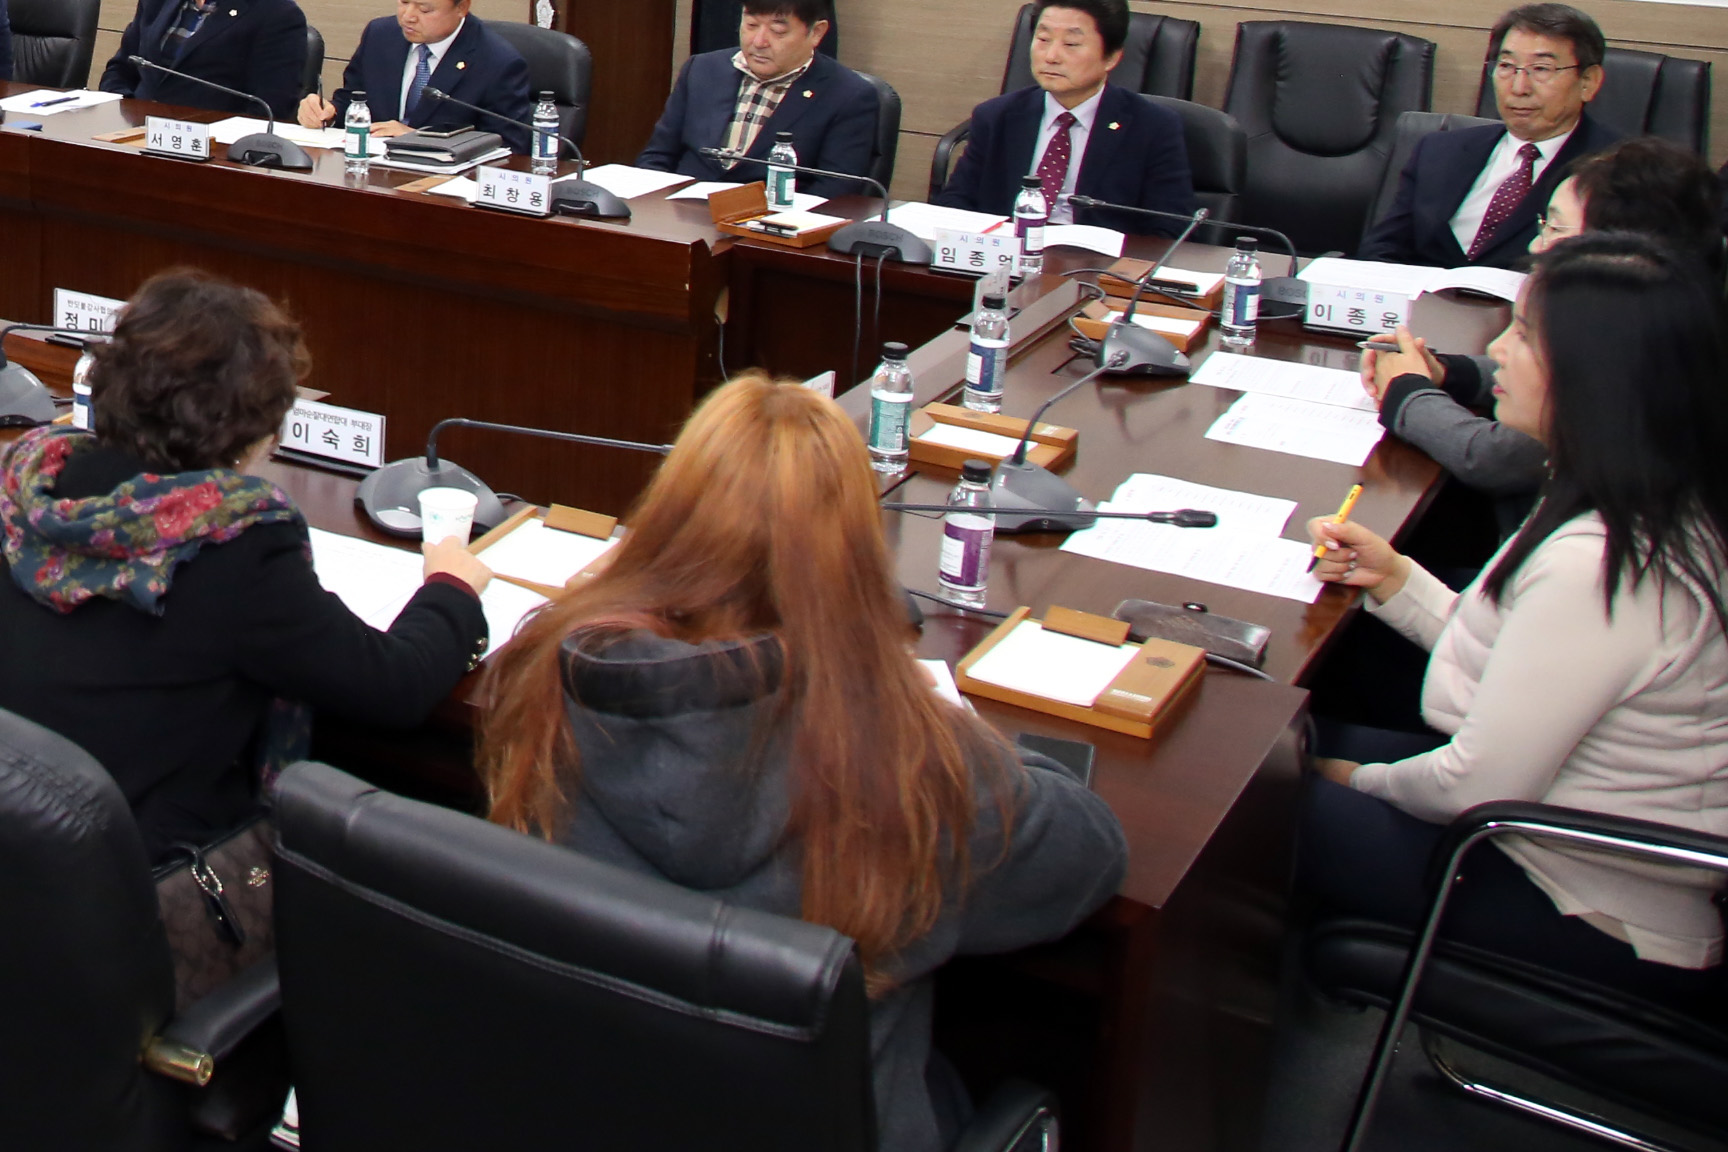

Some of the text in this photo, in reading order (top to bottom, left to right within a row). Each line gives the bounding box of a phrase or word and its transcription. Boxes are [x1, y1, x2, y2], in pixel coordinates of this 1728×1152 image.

[151, 133, 202, 152] 서영훈
[483, 184, 543, 207] 최창용
[960, 235, 1001, 247] 시의원
[1337, 289, 1385, 304] 시의원
[65, 311, 104, 331] 정미
[1314, 303, 1400, 329] 이종윤
[292, 422, 370, 457] 이숙희
